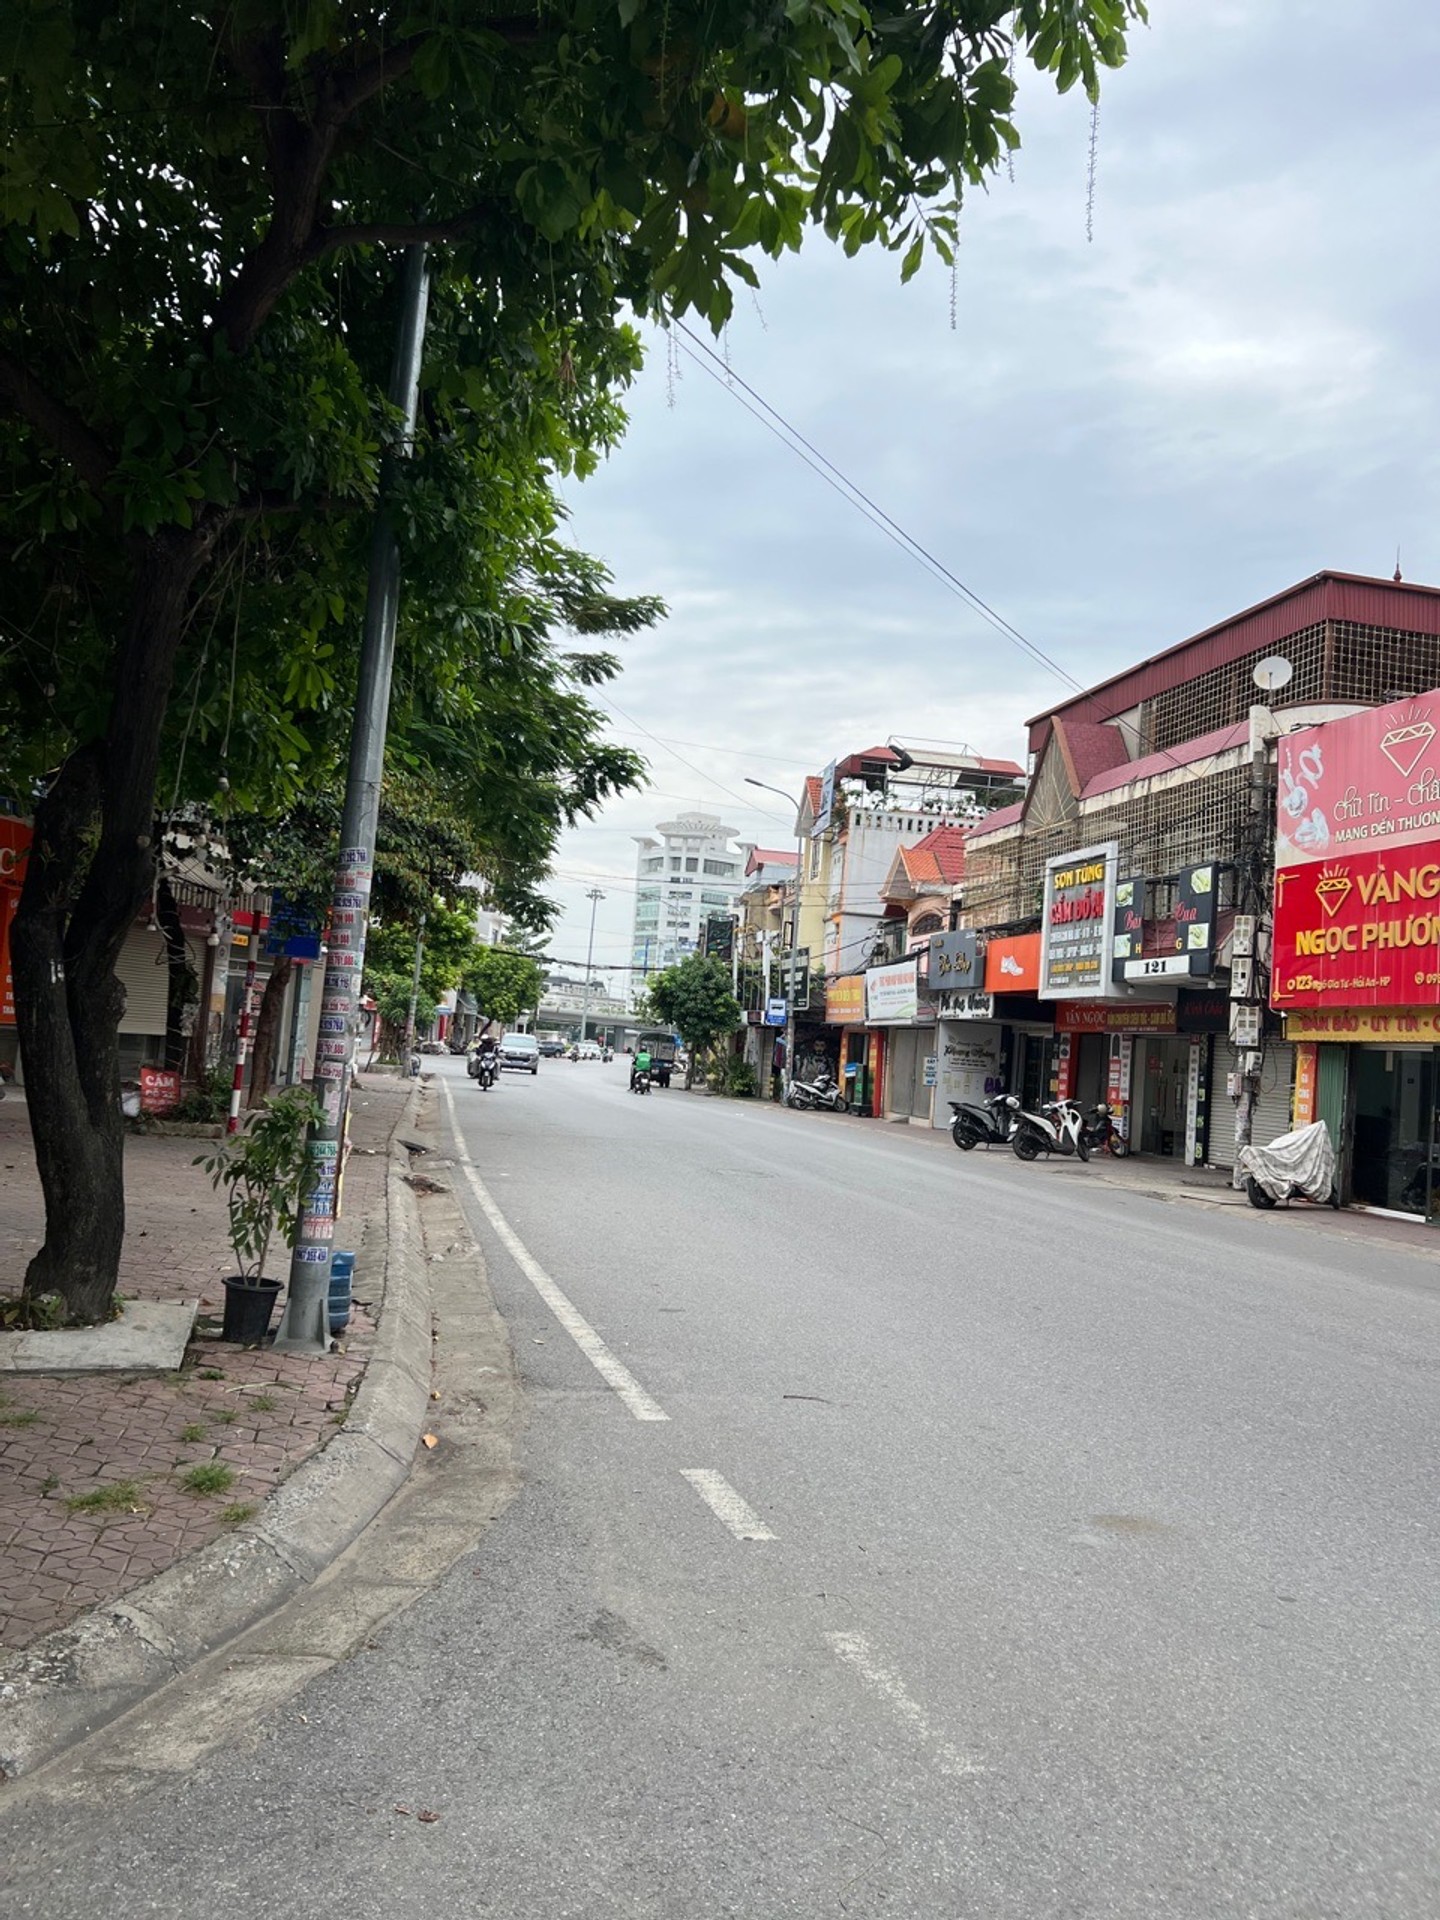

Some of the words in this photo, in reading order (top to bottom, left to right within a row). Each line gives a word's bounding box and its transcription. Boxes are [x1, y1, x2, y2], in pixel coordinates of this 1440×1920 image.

[1335, 825, 1368, 843] MANG
[1371, 816, 1395, 836] ĐẾN
[1357, 864, 1440, 905] VÀNG
[1296, 925, 1358, 960] NGỌC
[1143, 960, 1167, 975] 121
[1296, 974, 1313, 990] 123
[1380, 976, 1391, 987] HP
[1370, 1015, 1391, 1032] UY
[1395, 1010, 1419, 1032] TÍN
